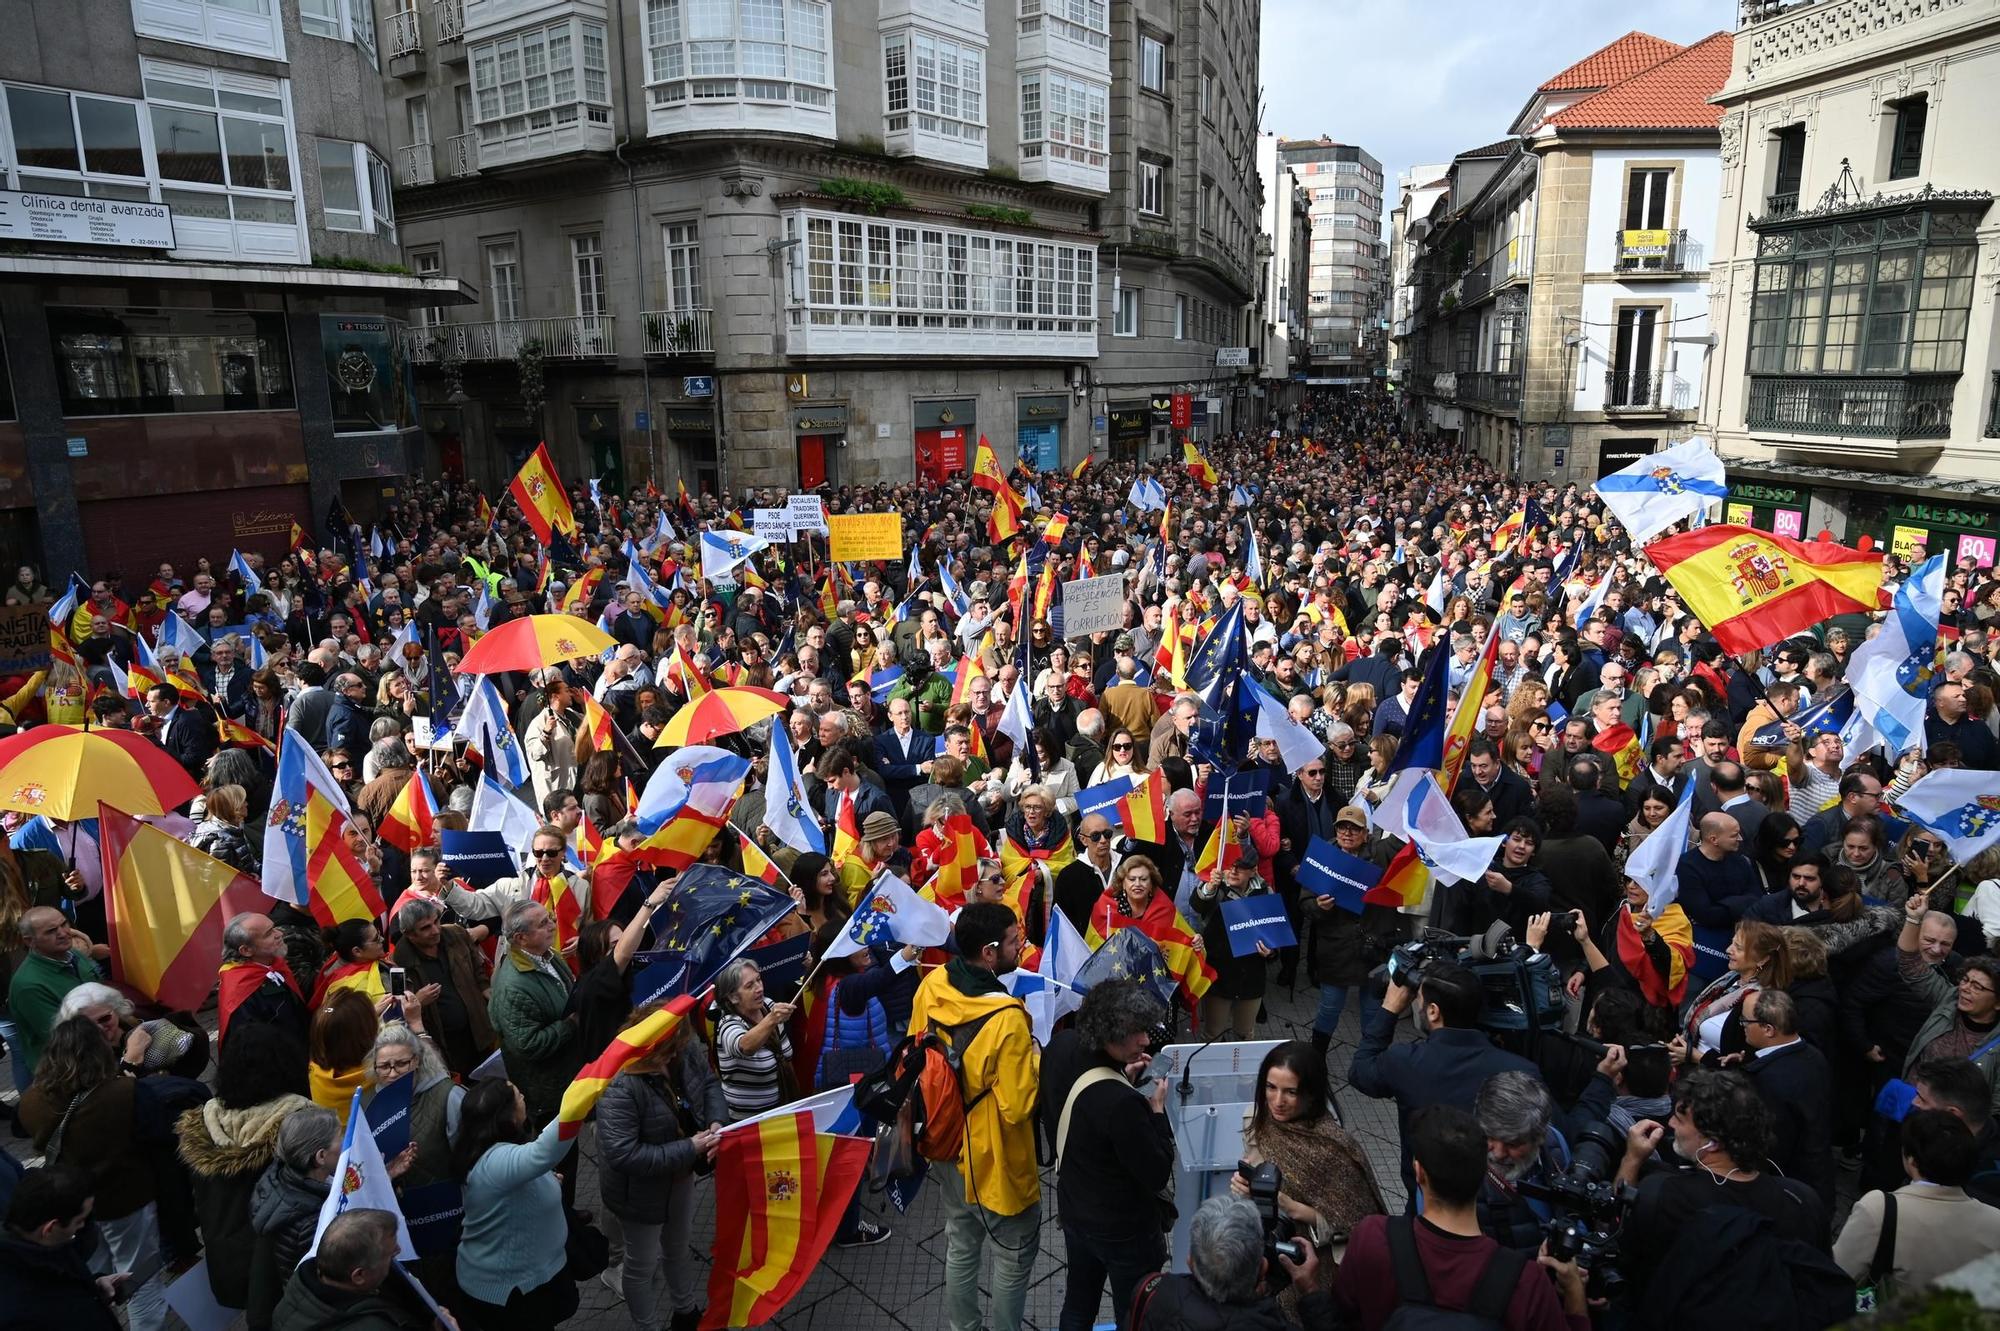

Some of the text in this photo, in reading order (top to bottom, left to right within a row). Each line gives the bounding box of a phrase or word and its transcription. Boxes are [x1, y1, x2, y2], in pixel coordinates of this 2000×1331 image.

[70, 200, 106, 214] dental
[111, 205, 165, 218] avanzada
[354, 323, 386, 331] TISSOT
[768, 511, 781, 519] PSOE
[755, 521, 772, 529] PEDRO
[1728, 516, 1748, 525] BLACK
[1107, 578, 1119, 587] LA
[1083, 600, 1099, 612] ES
[1306, 857, 1369, 891] #ESPAÑANOSERINDE
[1230, 915, 1286, 931] #ESPAÑANOSERINDE
